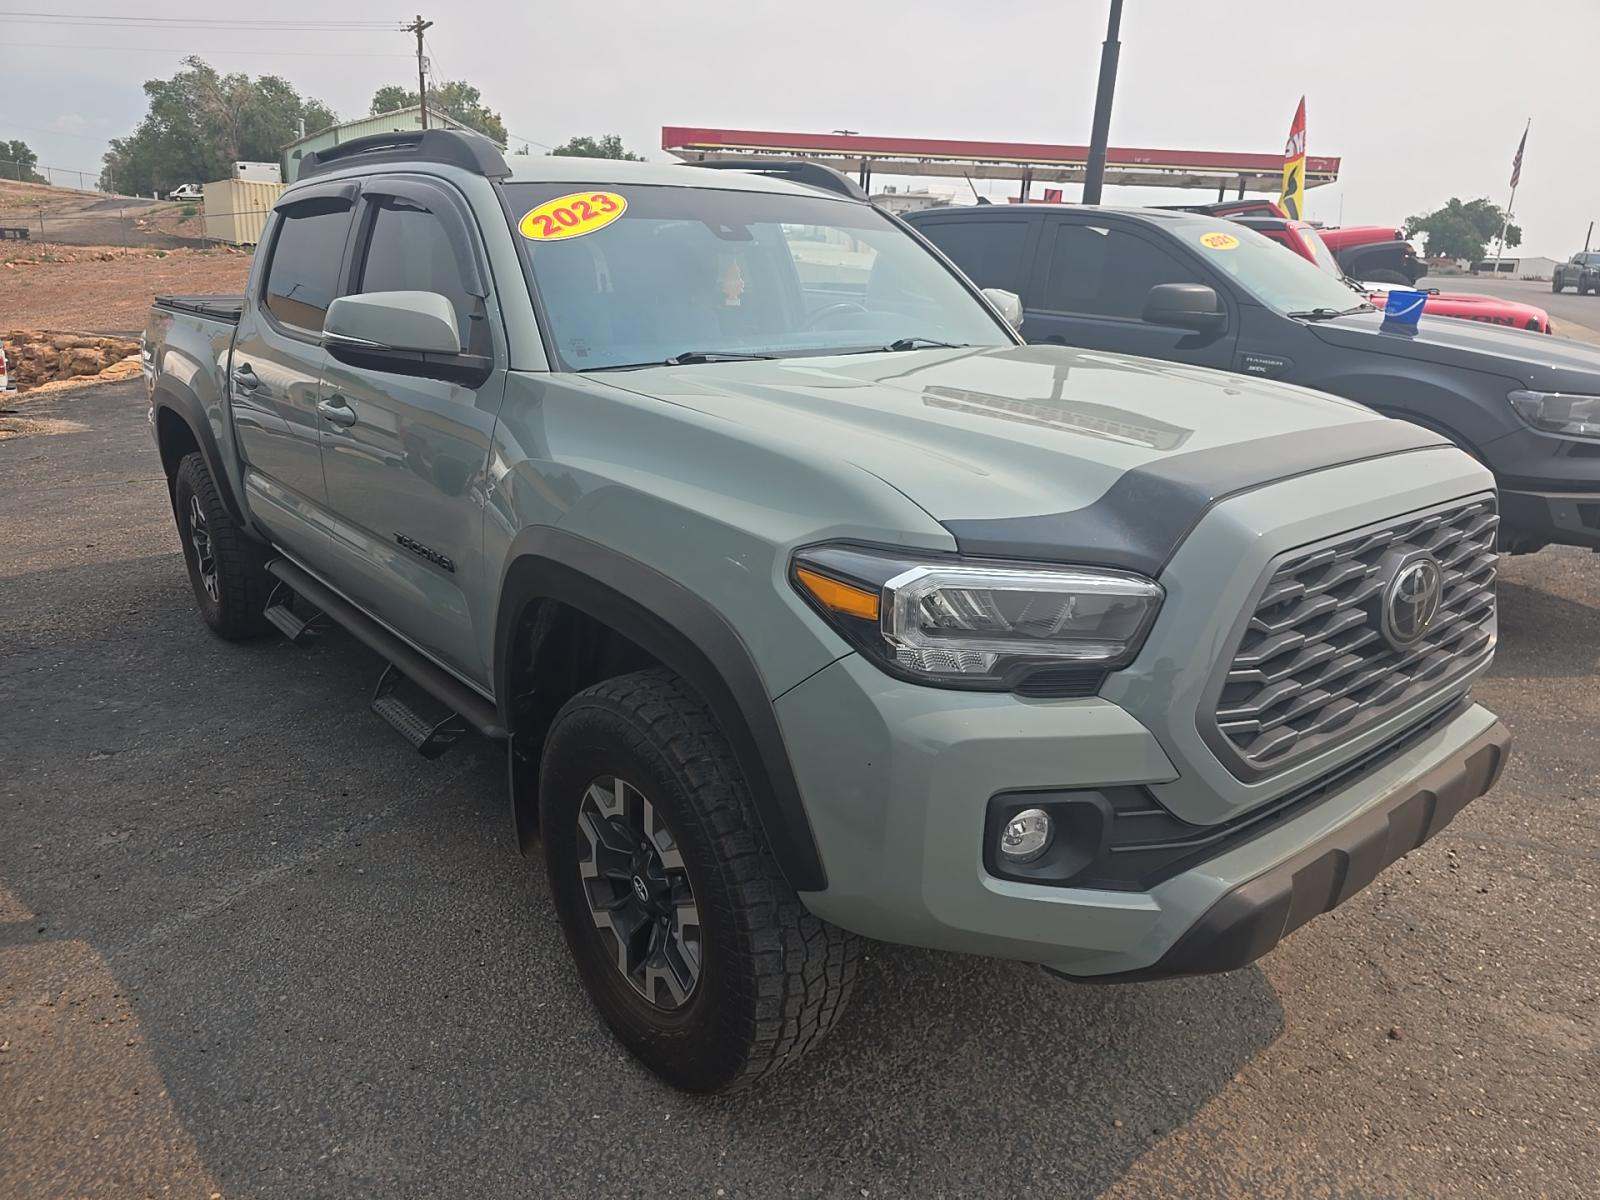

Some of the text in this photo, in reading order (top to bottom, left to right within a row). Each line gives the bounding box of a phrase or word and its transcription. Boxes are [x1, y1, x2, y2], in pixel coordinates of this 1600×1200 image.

[532, 194, 617, 236] 2023
[1246, 357, 1283, 366] RANGER
[393, 531, 455, 573] TACOMA
